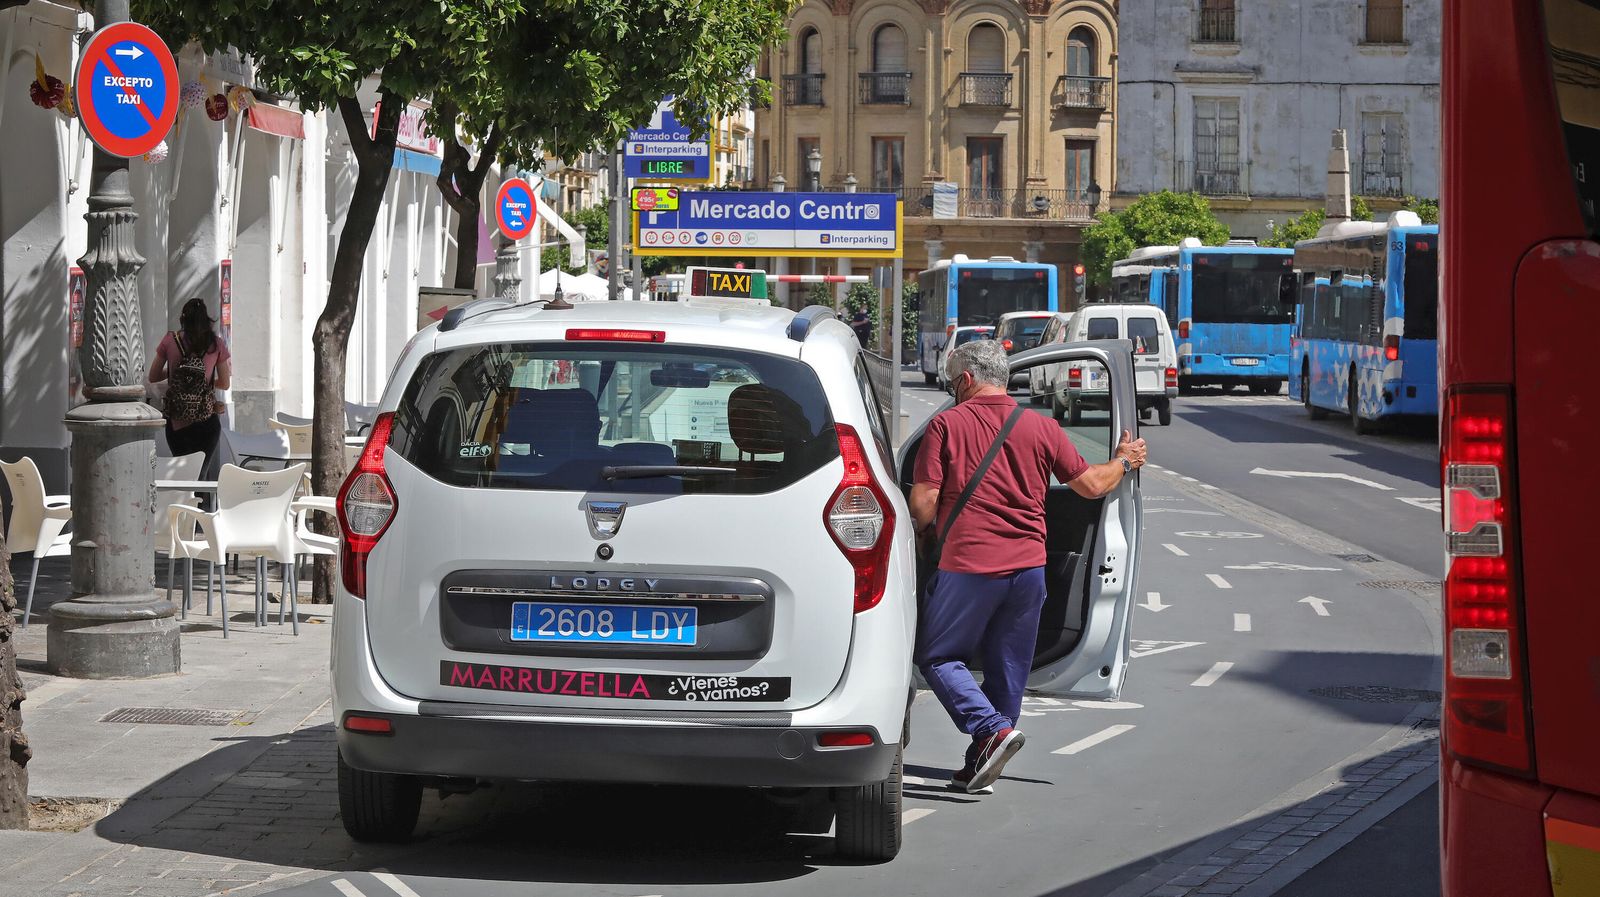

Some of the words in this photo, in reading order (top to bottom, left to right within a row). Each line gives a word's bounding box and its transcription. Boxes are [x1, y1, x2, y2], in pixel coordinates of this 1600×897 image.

[104, 76, 153, 88] EXCEPTO
[116, 94, 141, 105] TAXI
[630, 132, 670, 141] Mercado
[645, 144, 702, 156] Interparking
[648, 161, 684, 174] LIBRE
[690, 199, 791, 220] Mercado
[831, 234, 888, 245] Interparking
[709, 273, 751, 293] TAXI
[459, 446, 481, 456] elf
[551, 576, 659, 591] LODGY
[537, 608, 614, 638] 2608
[631, 611, 689, 640] LDY
[450, 662, 651, 699] MARRUZELLA
[667, 675, 738, 695] ¿Vienes
[685, 691, 697, 702] o
[700, 681, 770, 702] vamos?
